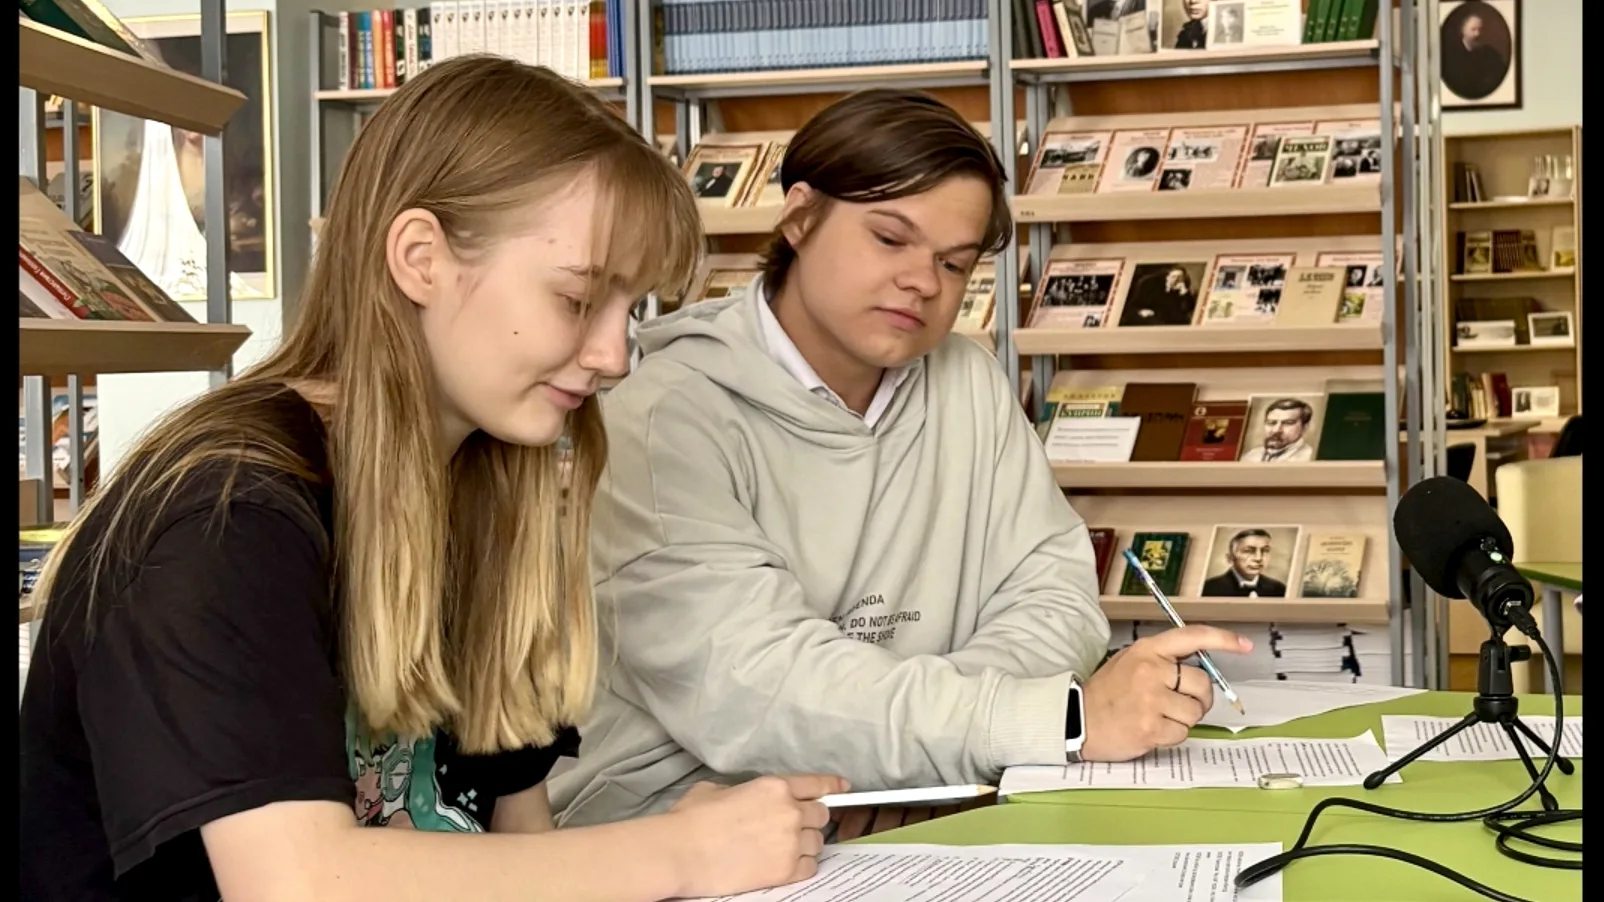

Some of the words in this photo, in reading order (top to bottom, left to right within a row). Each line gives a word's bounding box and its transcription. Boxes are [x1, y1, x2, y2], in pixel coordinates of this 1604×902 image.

[850, 617, 866, 629] DO
[869, 615, 888, 628] NOT
[856, 631, 877, 644] THE
